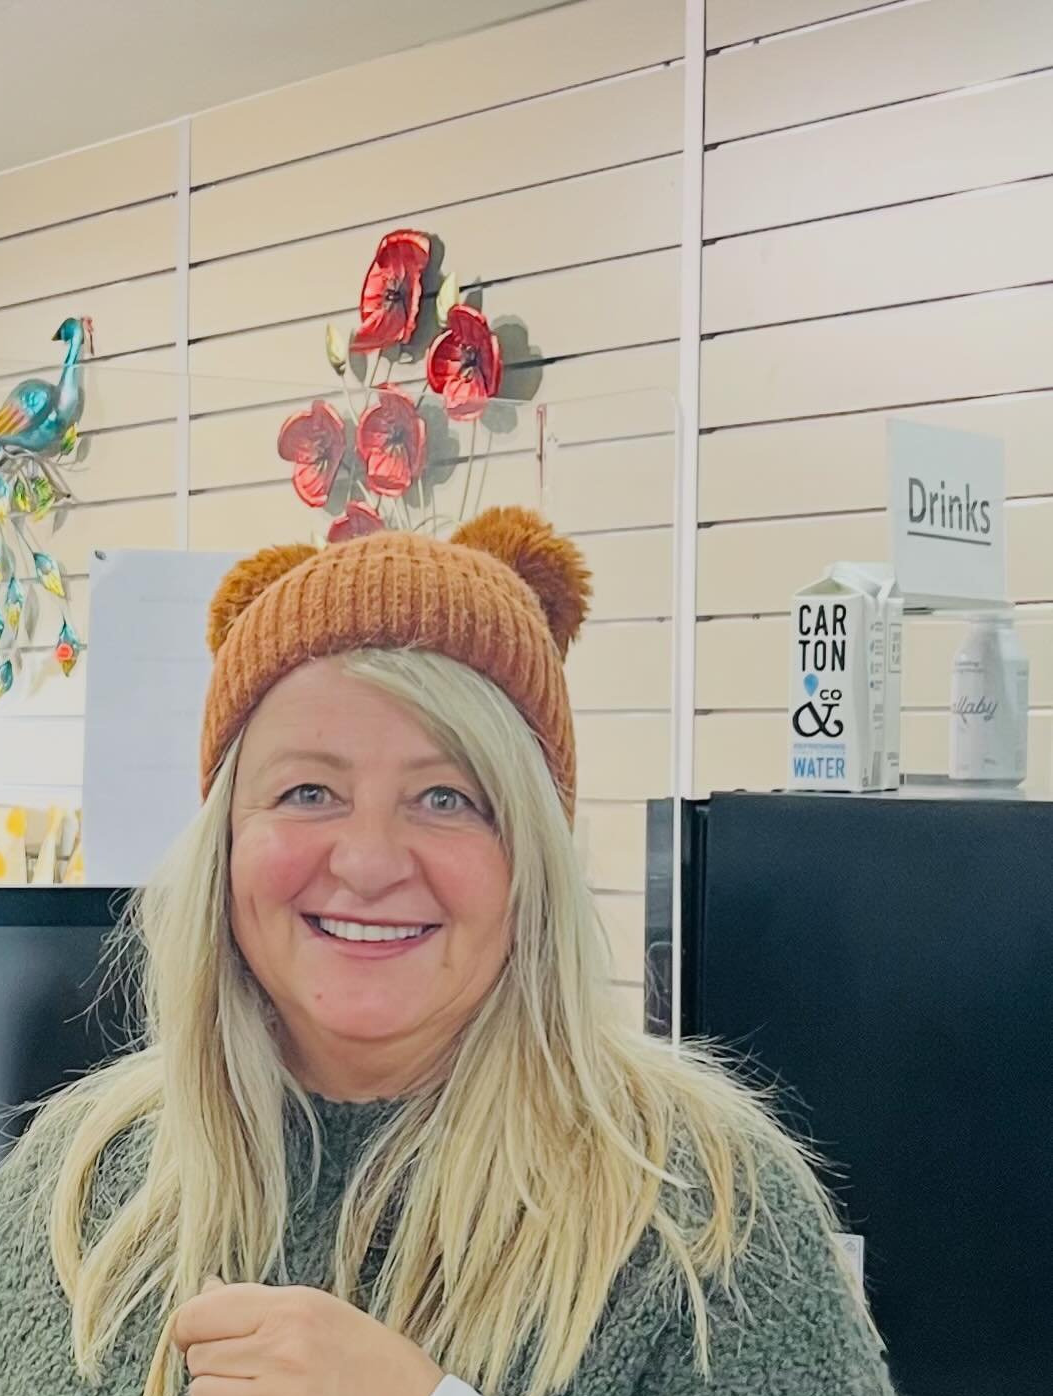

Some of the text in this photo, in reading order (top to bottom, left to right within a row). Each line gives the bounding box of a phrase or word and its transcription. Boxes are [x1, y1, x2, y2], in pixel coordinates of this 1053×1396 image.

[908, 477, 991, 535] Drinks
[799, 604, 847, 636] CAR
[799, 639, 846, 672] TON
[820, 688, 843, 701] CO
[793, 757, 845, 778] WATER
